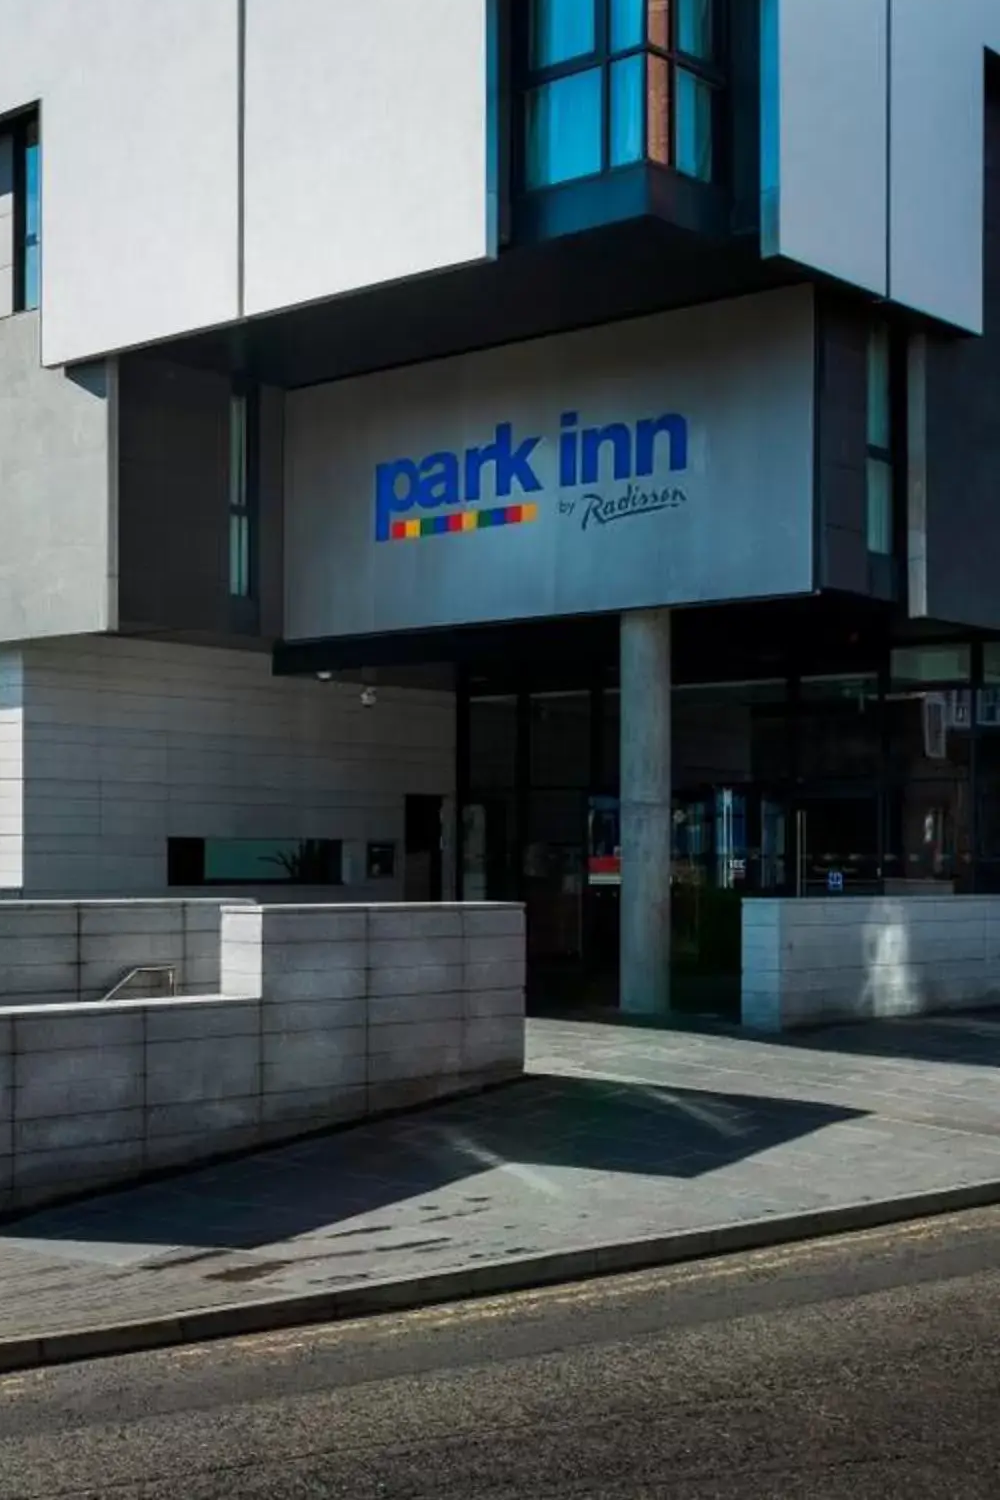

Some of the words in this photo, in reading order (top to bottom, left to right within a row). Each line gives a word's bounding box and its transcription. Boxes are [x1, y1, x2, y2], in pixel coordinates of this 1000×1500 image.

[375, 421, 543, 542] park
[559, 411, 688, 487] inn
[558, 500, 575, 516] by
[581, 483, 688, 531] Radisson
